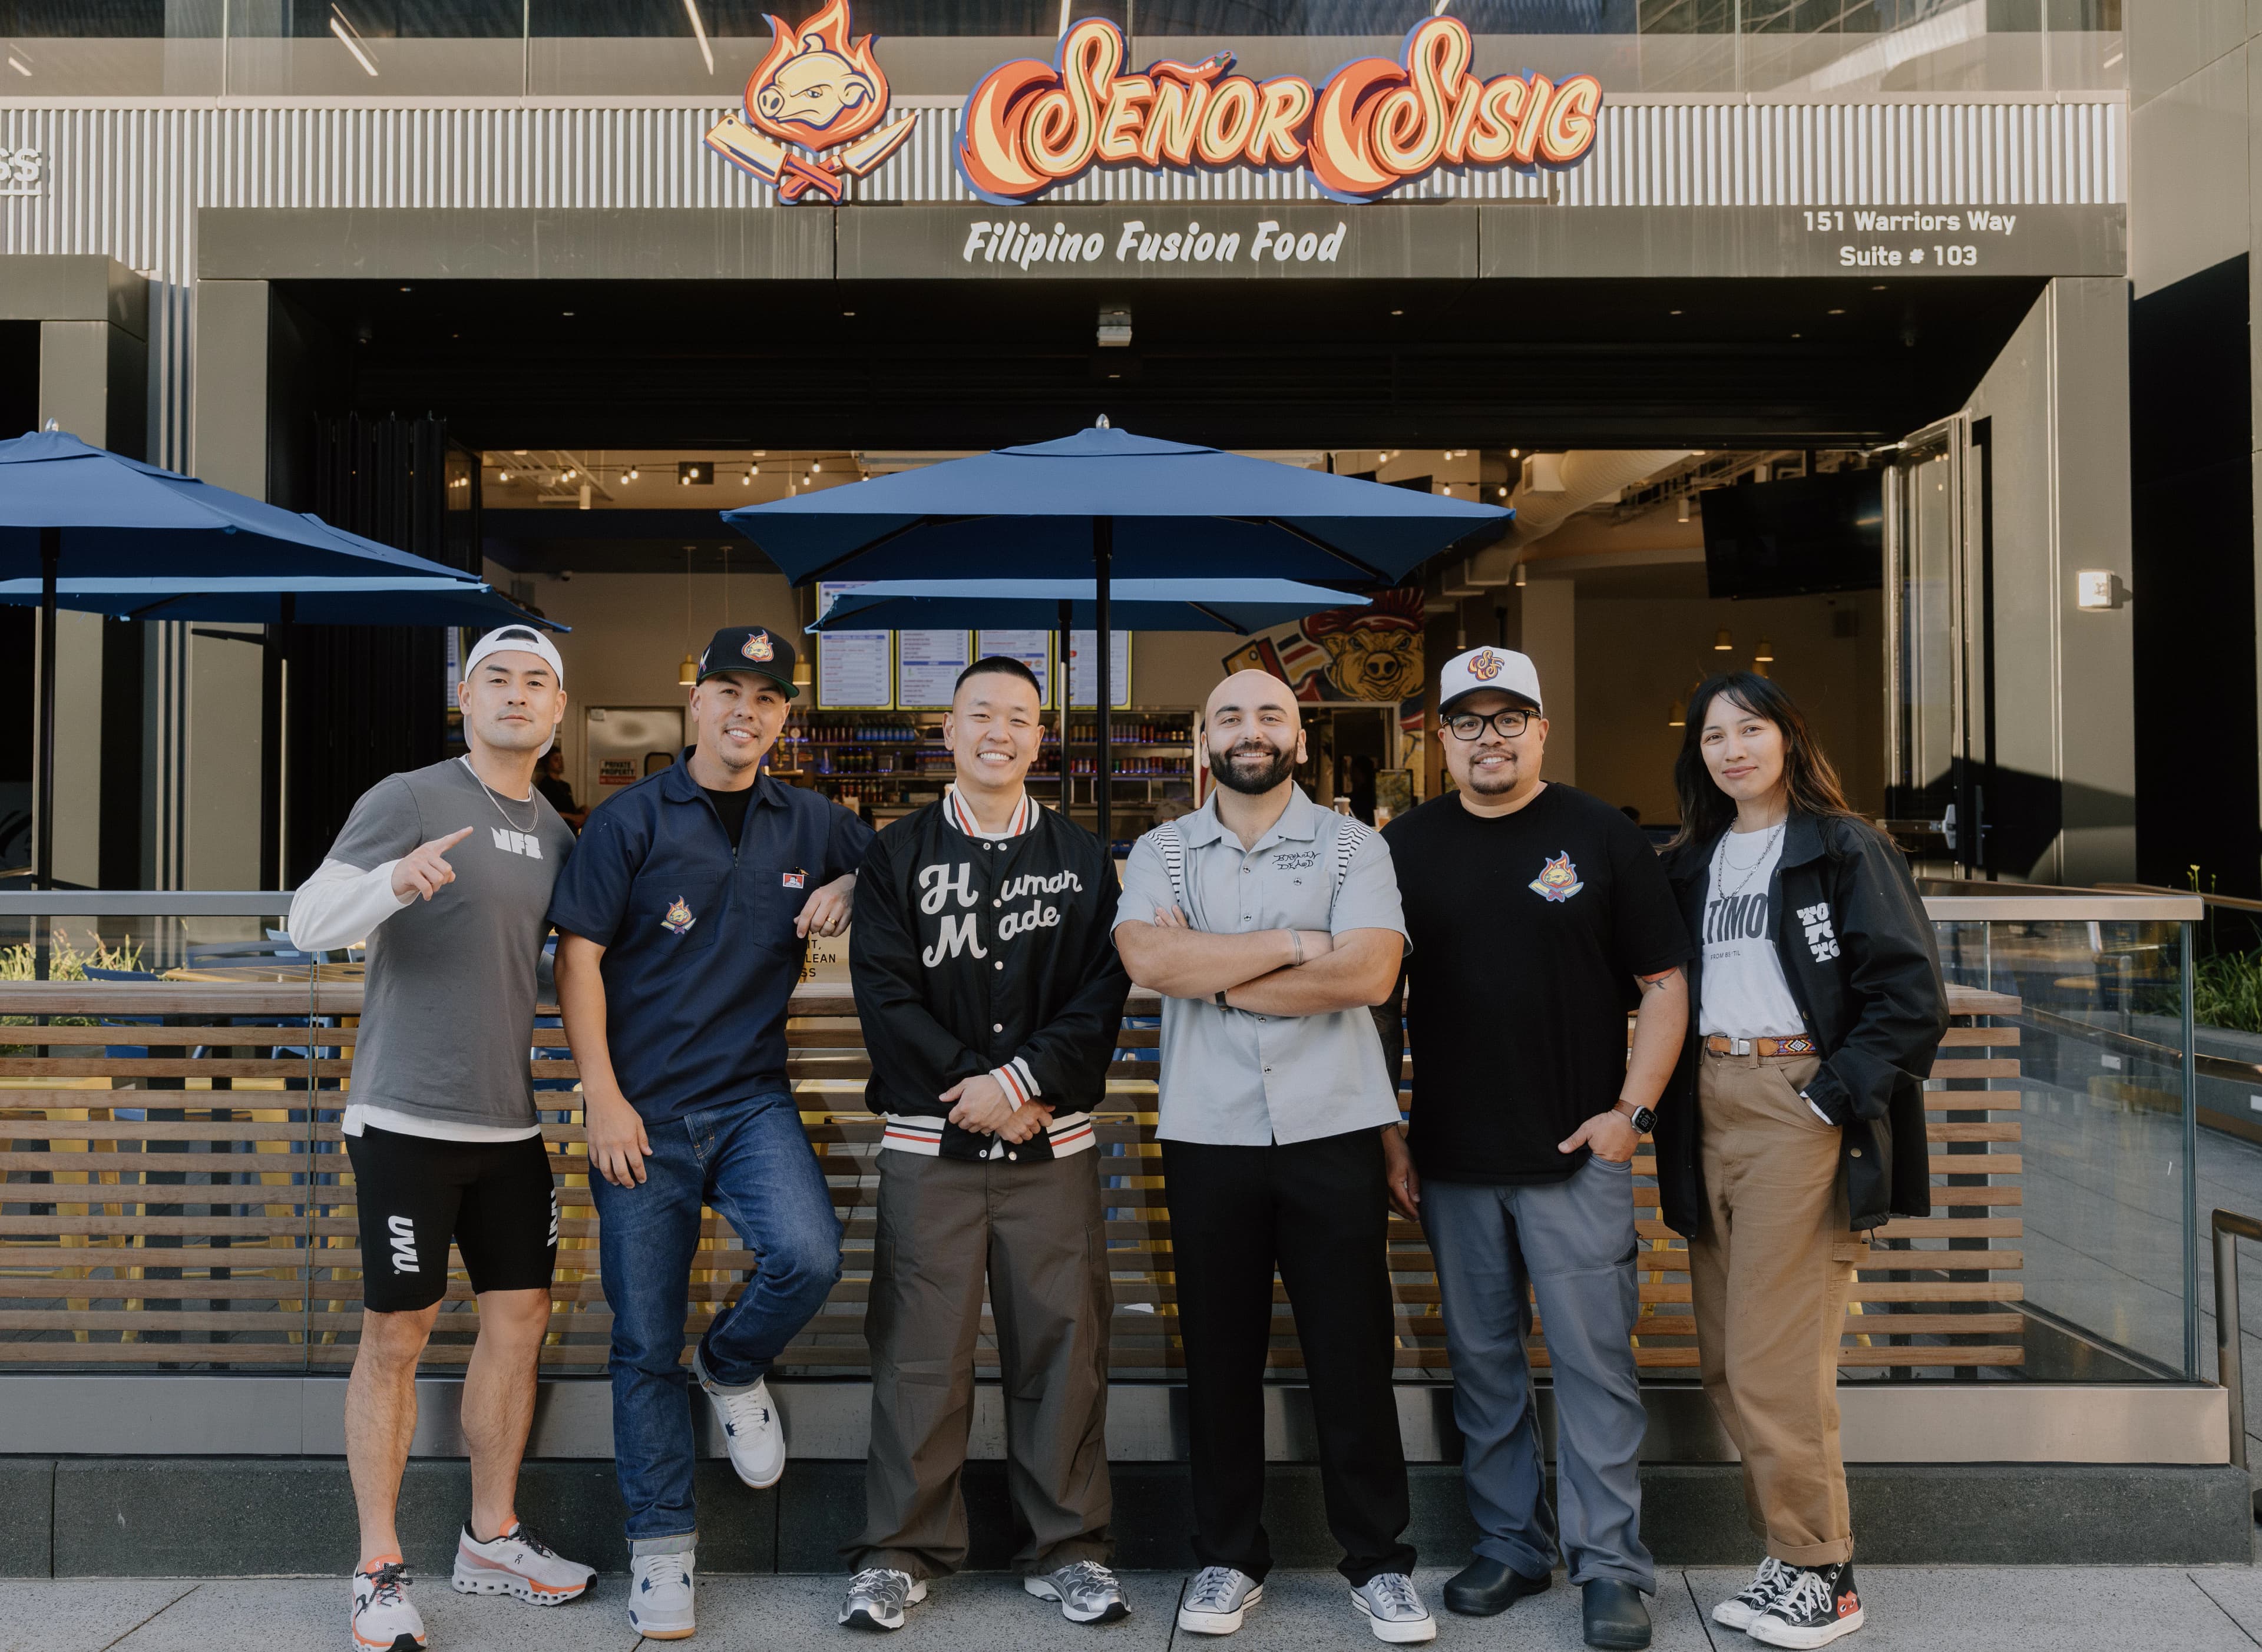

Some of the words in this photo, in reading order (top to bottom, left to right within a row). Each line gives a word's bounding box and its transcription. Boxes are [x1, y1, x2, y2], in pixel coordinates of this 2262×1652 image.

[1309, 16, 1602, 203] SISIG
[963, 220, 1105, 271] Filipino
[1116, 220, 1241, 262] Fusion
[1250, 221, 1347, 262] Food
[1803, 211, 1844, 231] 151
[1853, 211, 1961, 231] Warriors
[1967, 211, 2016, 236] Way
[1839, 246, 1901, 267] Suite
[1909, 248, 1924, 264] #
[1934, 246, 1978, 266] 103
[1702, 893, 1772, 946] TIMO
[388, 1215, 420, 1272] UVU
